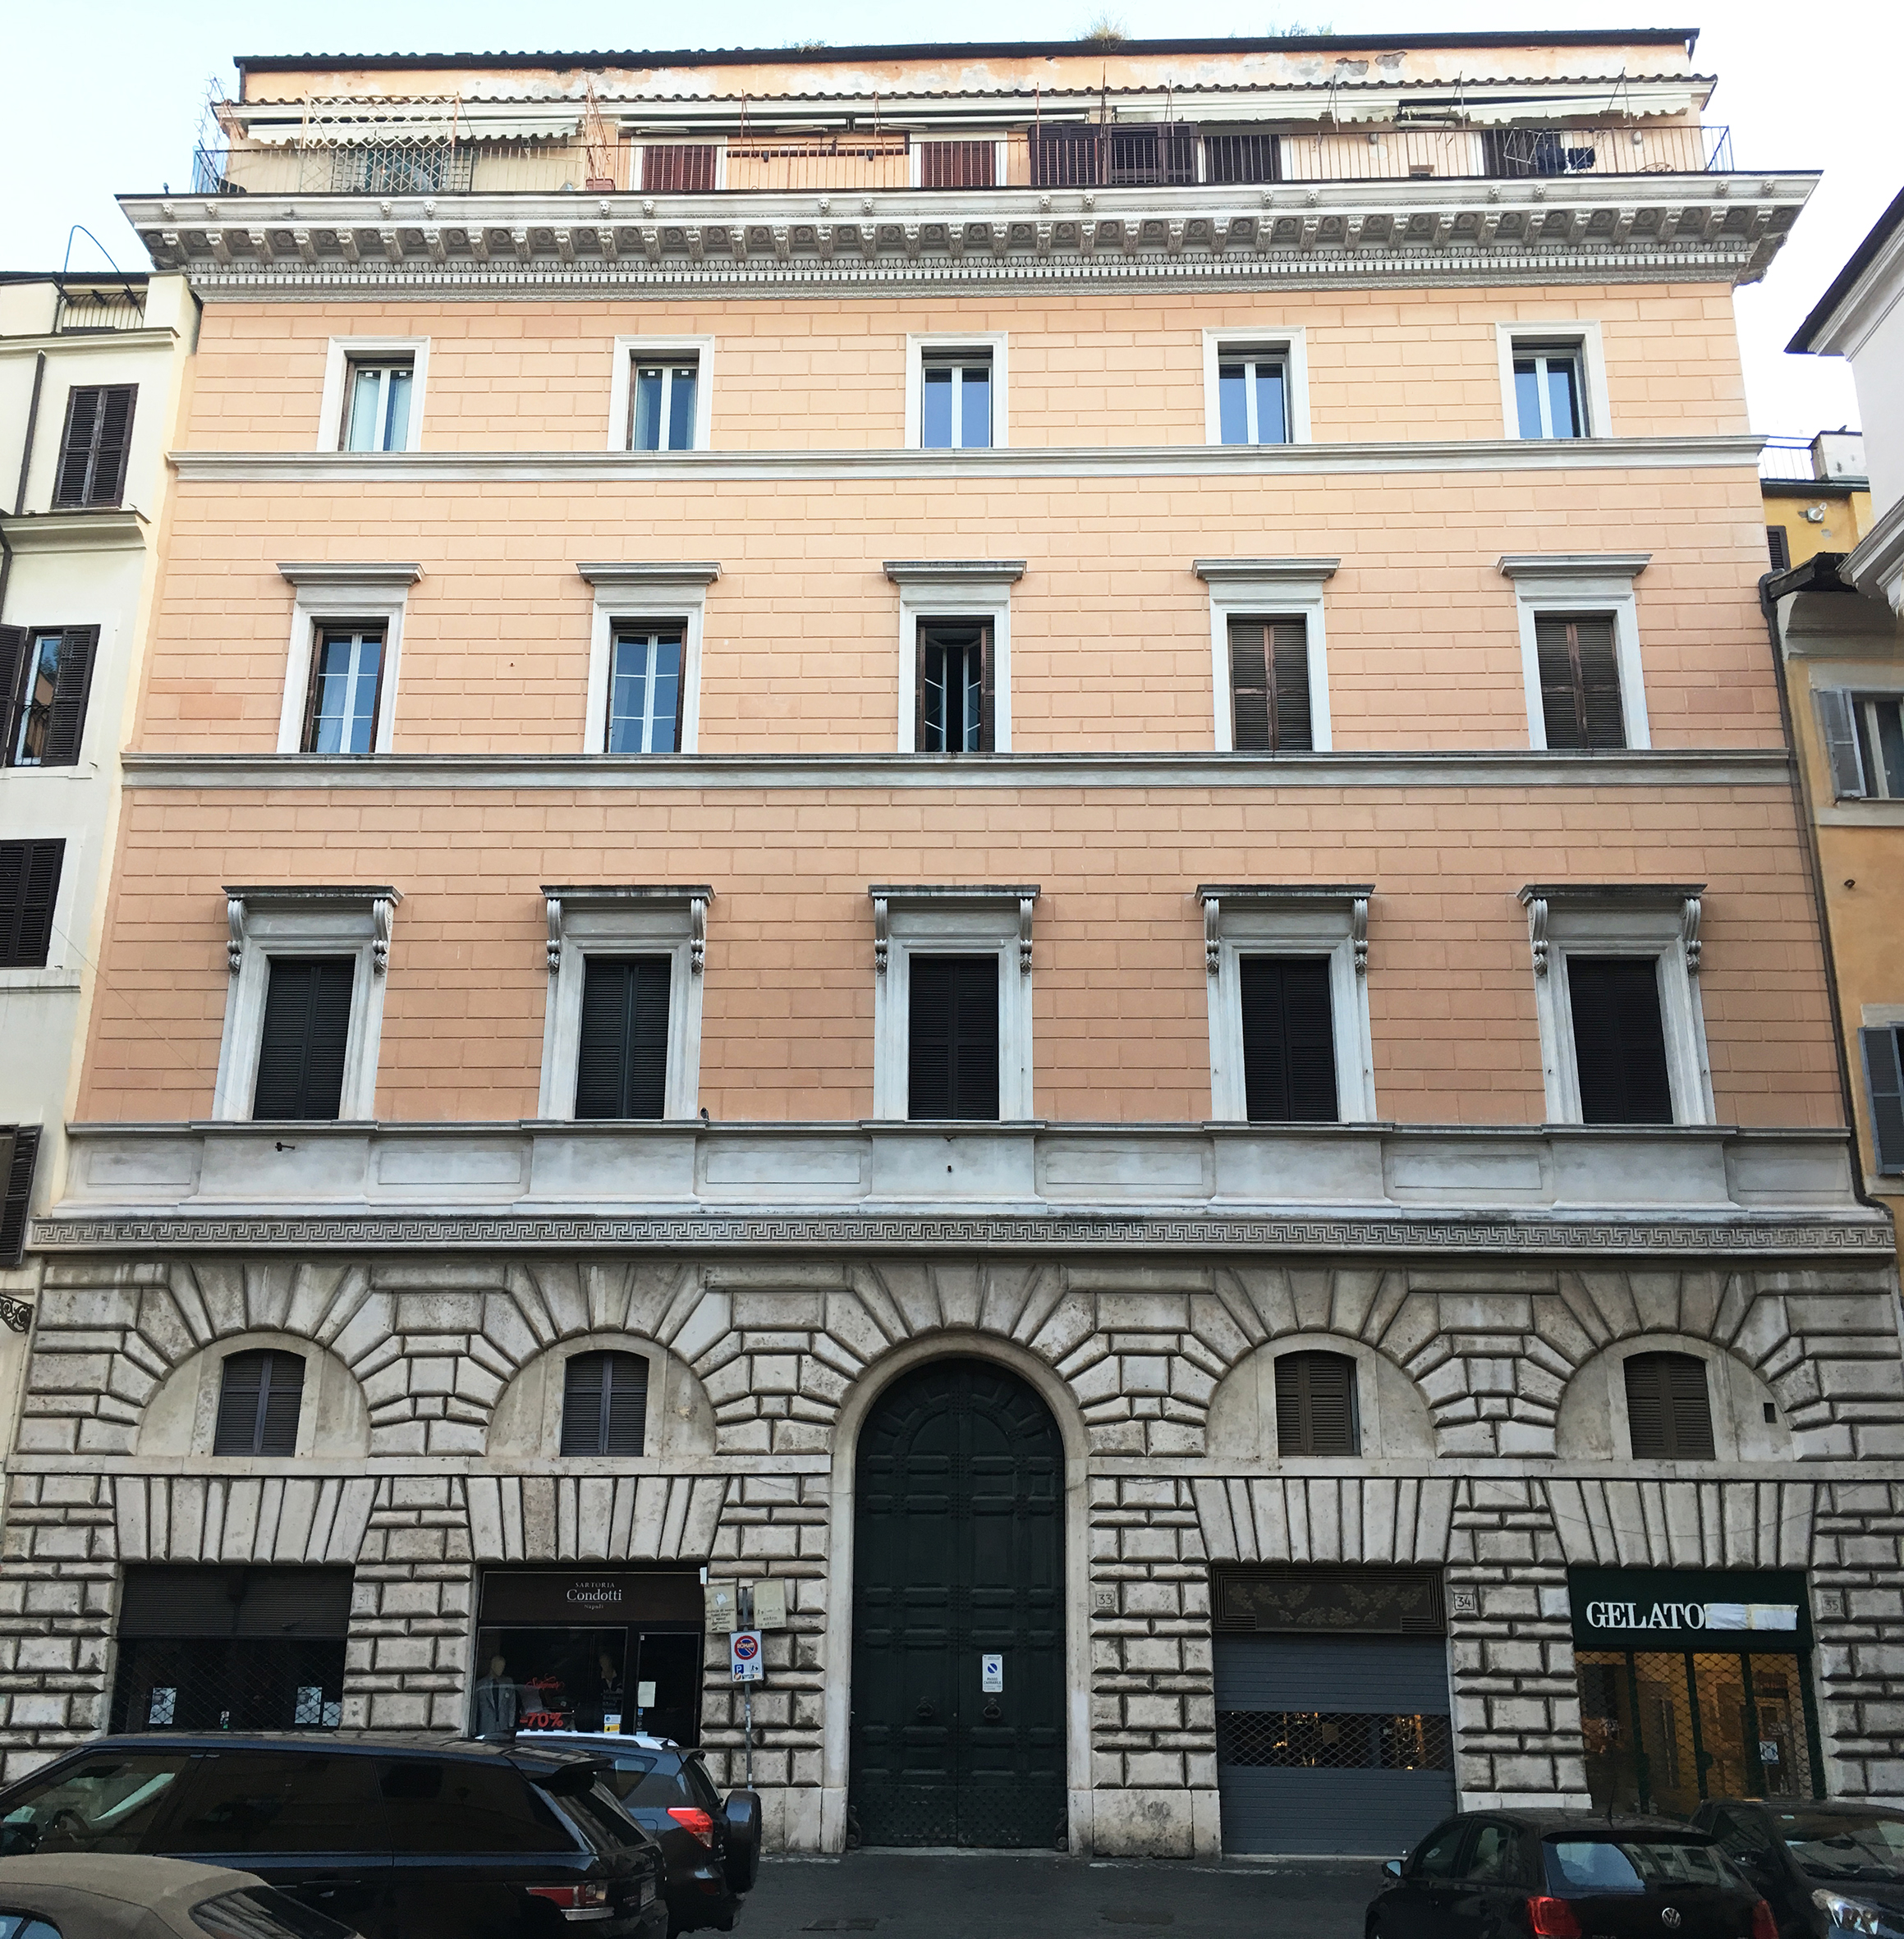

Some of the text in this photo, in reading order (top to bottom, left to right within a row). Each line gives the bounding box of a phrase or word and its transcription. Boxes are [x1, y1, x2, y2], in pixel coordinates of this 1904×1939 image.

[567, 1588, 622, 1601] Condotti
[1098, 1593, 1113, 1605] 33
[1457, 1596, 1471, 1607] 34
[1824, 1600, 1839, 1611] 35
[1585, 1602, 1705, 1630] GELATO
[520, 1712, 564, 1727] -70%
